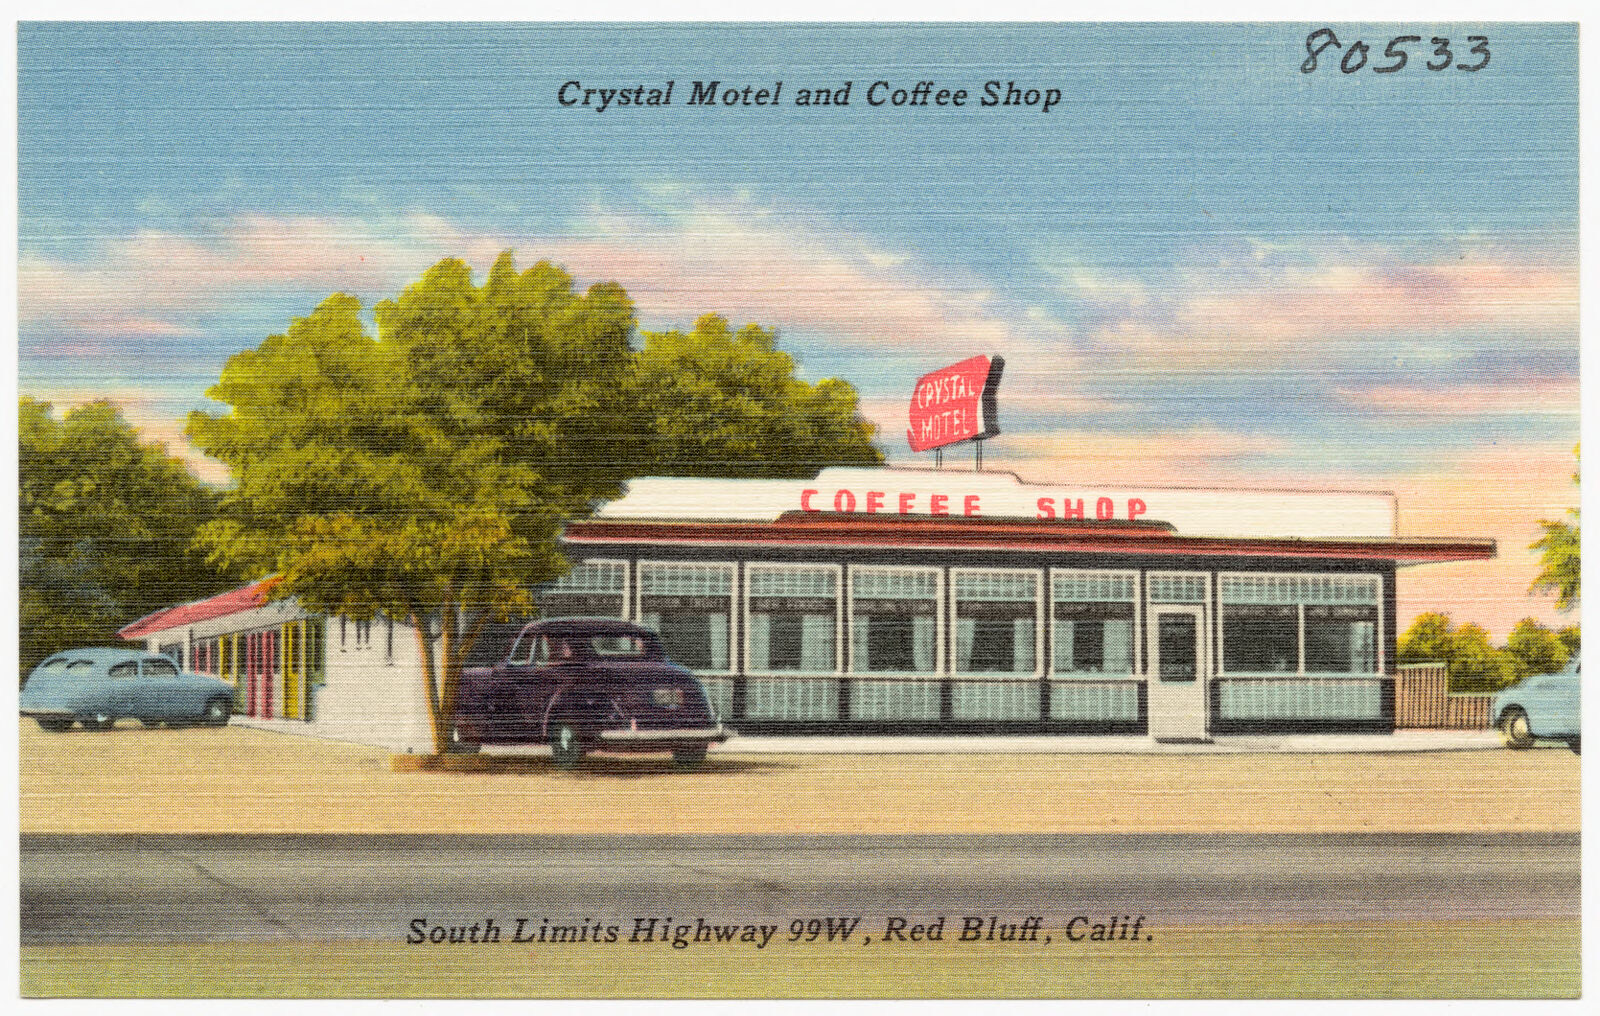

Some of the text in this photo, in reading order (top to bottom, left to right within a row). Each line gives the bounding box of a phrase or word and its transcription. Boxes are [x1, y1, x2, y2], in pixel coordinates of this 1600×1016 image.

[1300, 28, 1492, 75] 80533
[917, 374, 976, 410] CRYSTAL
[921, 407, 972, 443] MOTEL
[800, 489, 1148, 521] COFFEE SHOP
